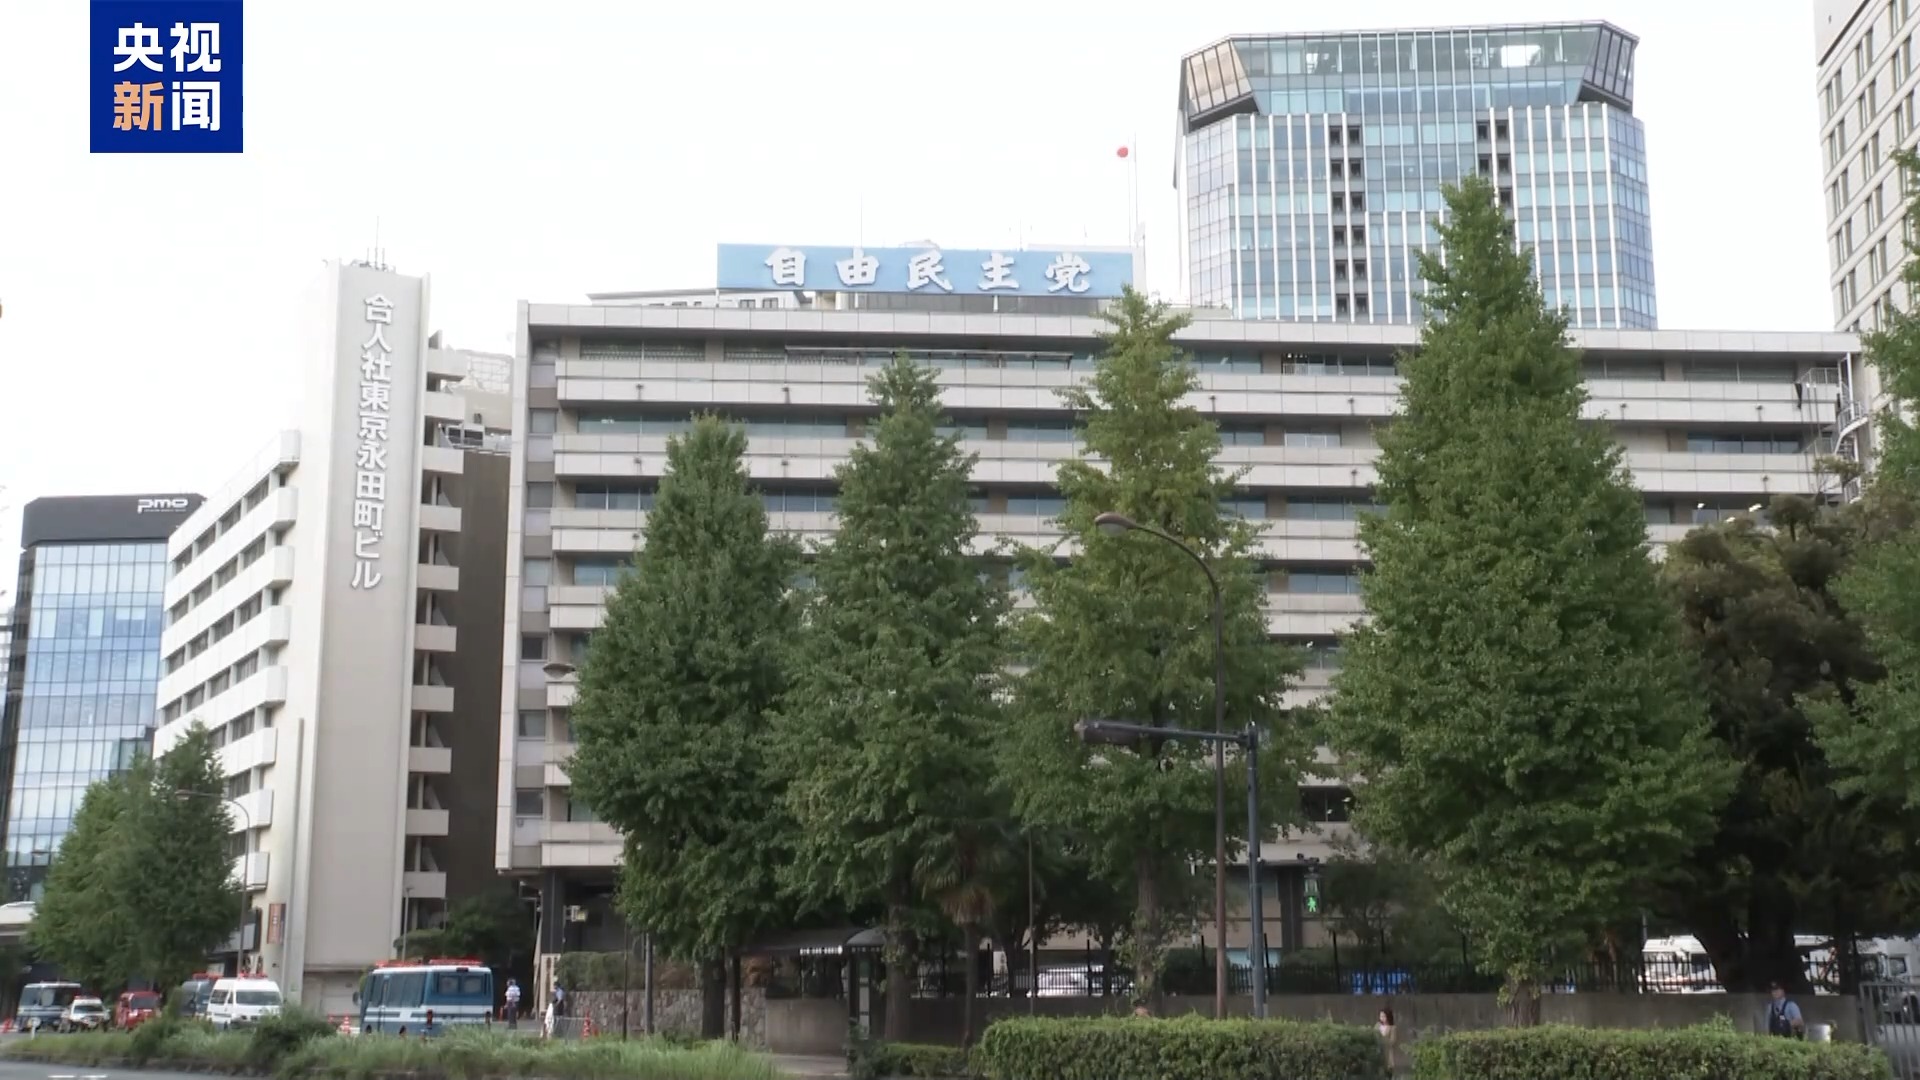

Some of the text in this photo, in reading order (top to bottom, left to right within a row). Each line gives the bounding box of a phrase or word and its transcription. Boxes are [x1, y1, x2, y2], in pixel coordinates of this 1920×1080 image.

[765, 248, 1091, 292] 自由民主党
[351, 293, 395, 589] 合人社東京永田町ビル
